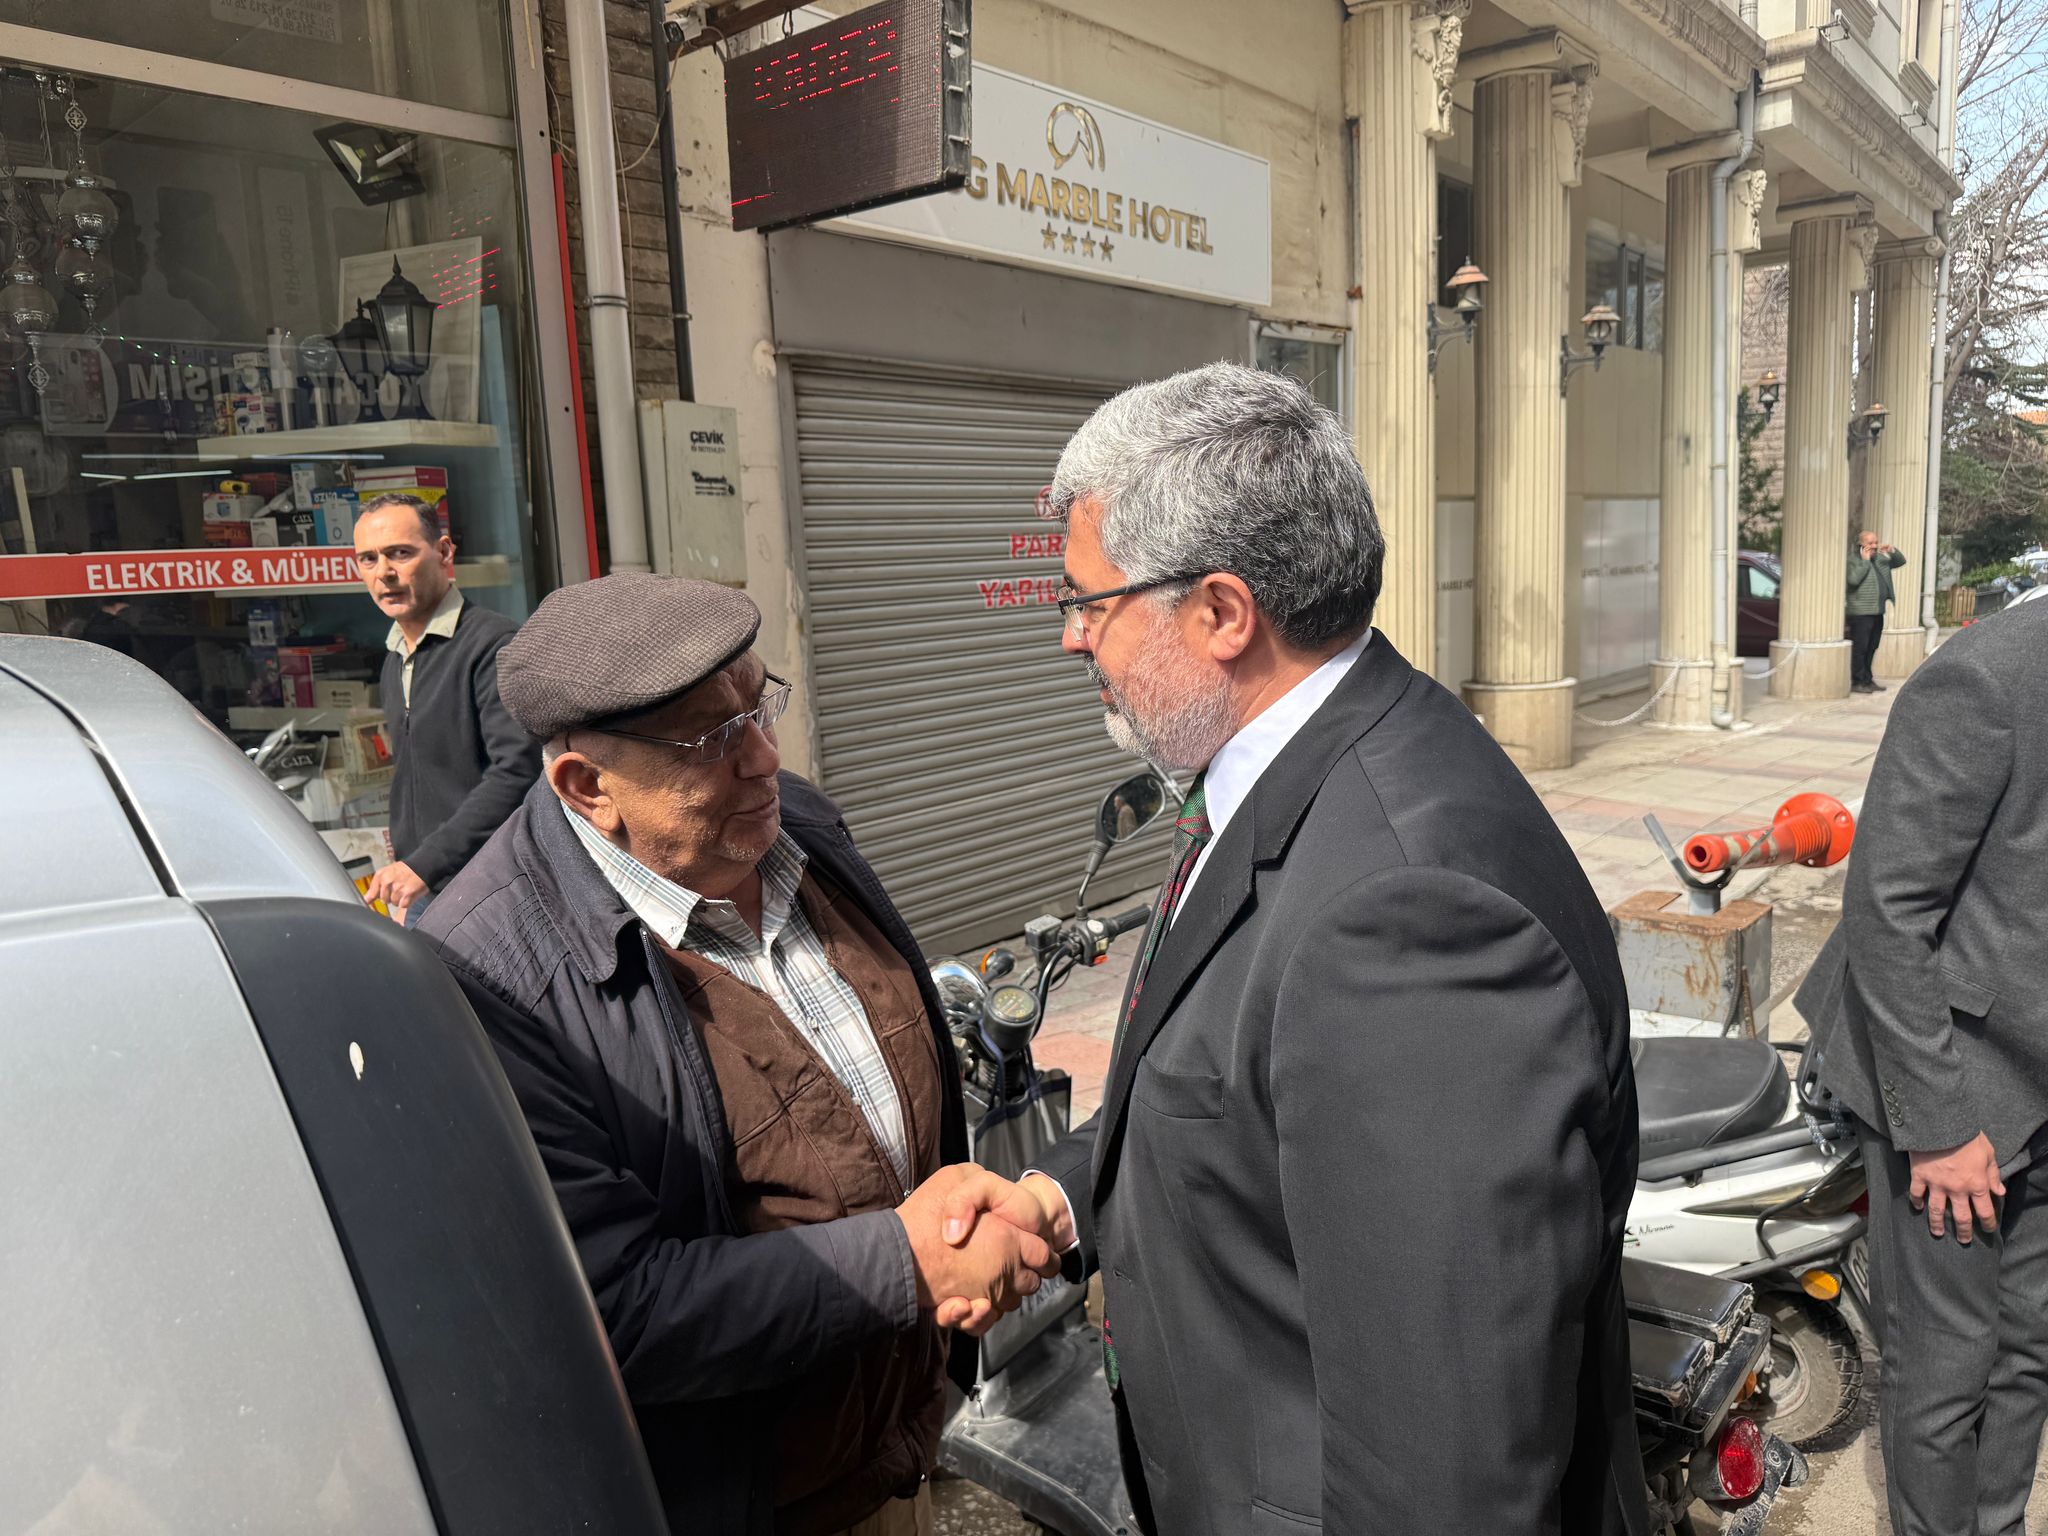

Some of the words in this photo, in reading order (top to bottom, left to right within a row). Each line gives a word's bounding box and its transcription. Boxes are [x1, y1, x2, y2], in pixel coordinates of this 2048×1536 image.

[996, 162, 1123, 233] MARBLE
[1128, 197, 1214, 256] HOTEL
[690, 429, 725, 446] ÇEVİK
[1010, 534, 1064, 559] PAR
[231, 558, 255, 584] &
